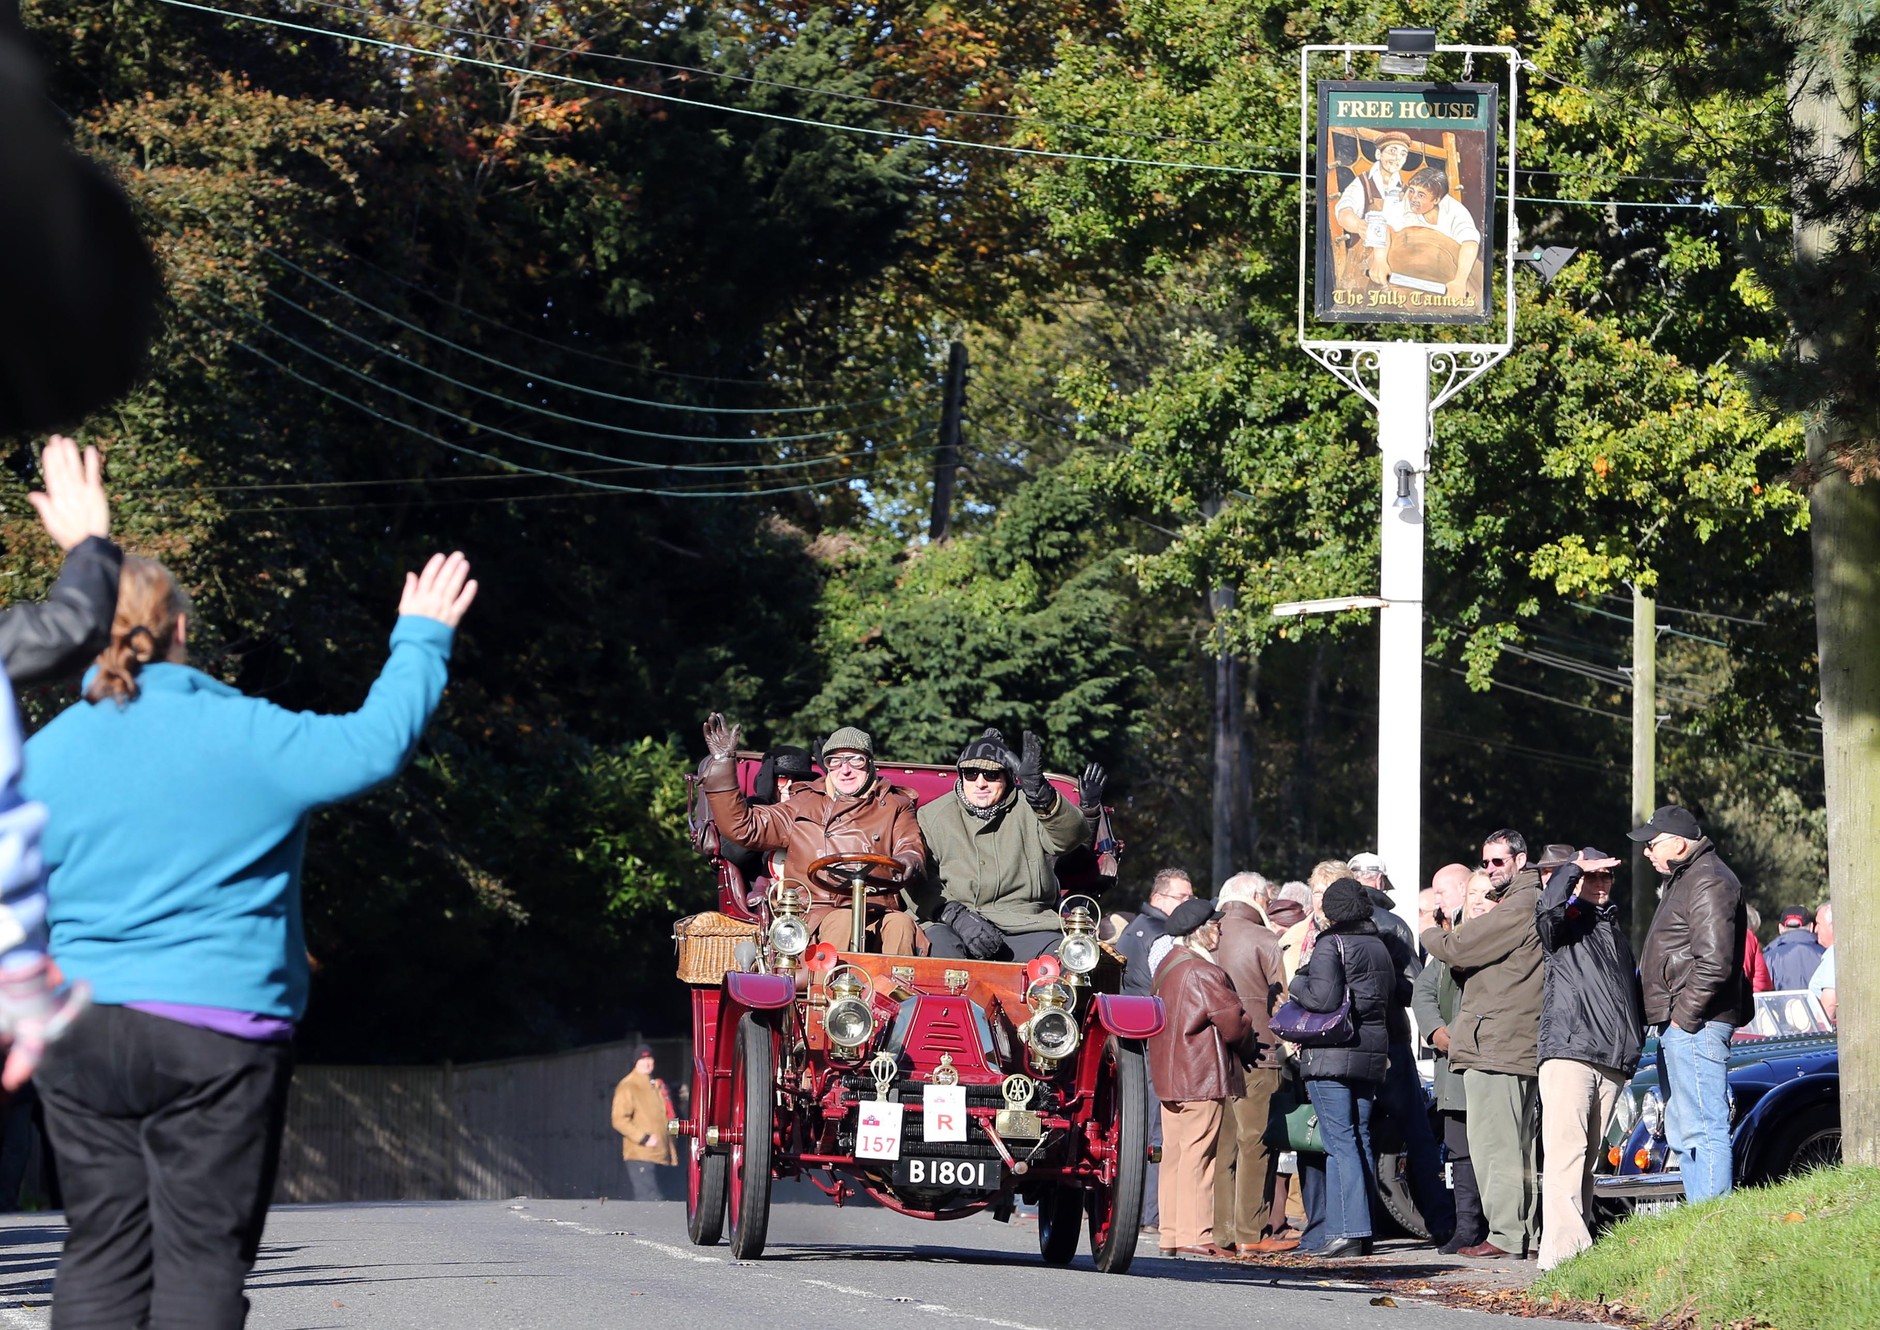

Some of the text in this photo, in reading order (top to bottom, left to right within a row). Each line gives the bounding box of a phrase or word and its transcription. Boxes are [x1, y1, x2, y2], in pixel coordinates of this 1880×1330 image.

[1337, 100, 1475, 120] FREE HOUSE
[1332, 289, 1476, 308] The Jolly Tanners
[937, 1114, 954, 1131] R
[863, 1135, 896, 1153] 157
